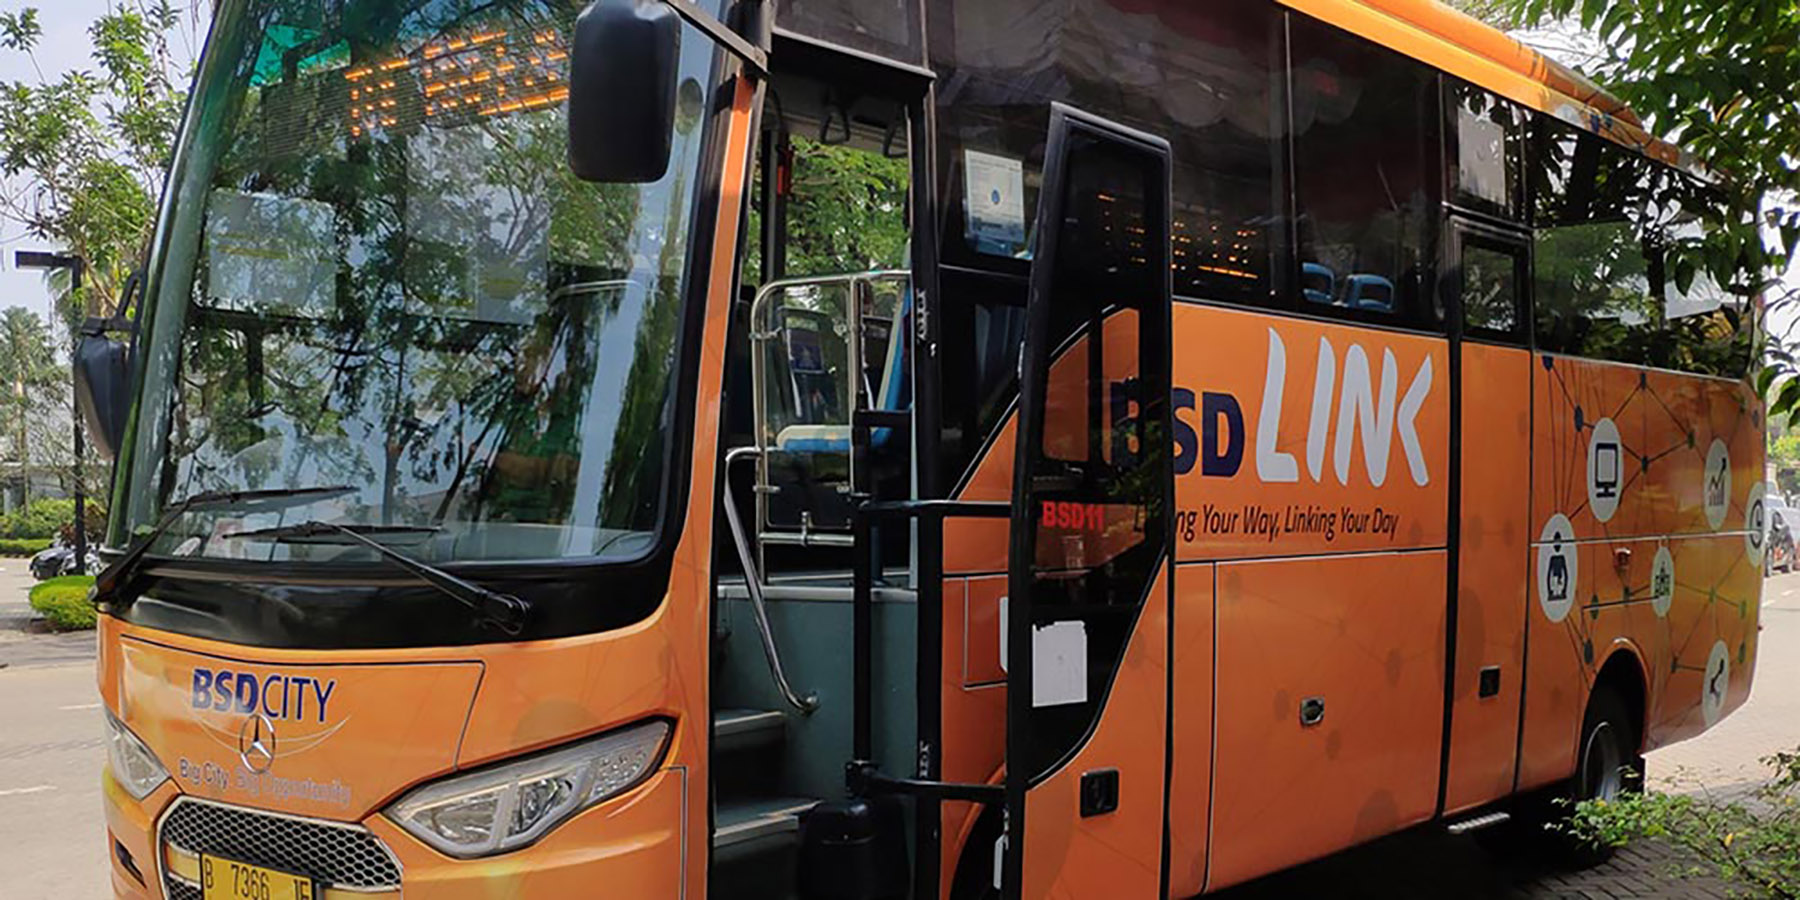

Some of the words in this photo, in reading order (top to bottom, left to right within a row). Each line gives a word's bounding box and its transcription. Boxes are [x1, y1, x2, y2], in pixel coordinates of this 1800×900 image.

[1255, 326, 1433, 489] LINK
[1042, 500, 1105, 532] BSD11
[1202, 503, 1238, 535] Your
[1243, 505, 1280, 542] Way,
[1284, 505, 1336, 542] Linking
[1340, 506, 1370, 534] Your
[1372, 507, 1399, 541] Day
[179, 758, 201, 786] Big
[204, 858, 214, 889] B
[230, 863, 270, 900] 7366
